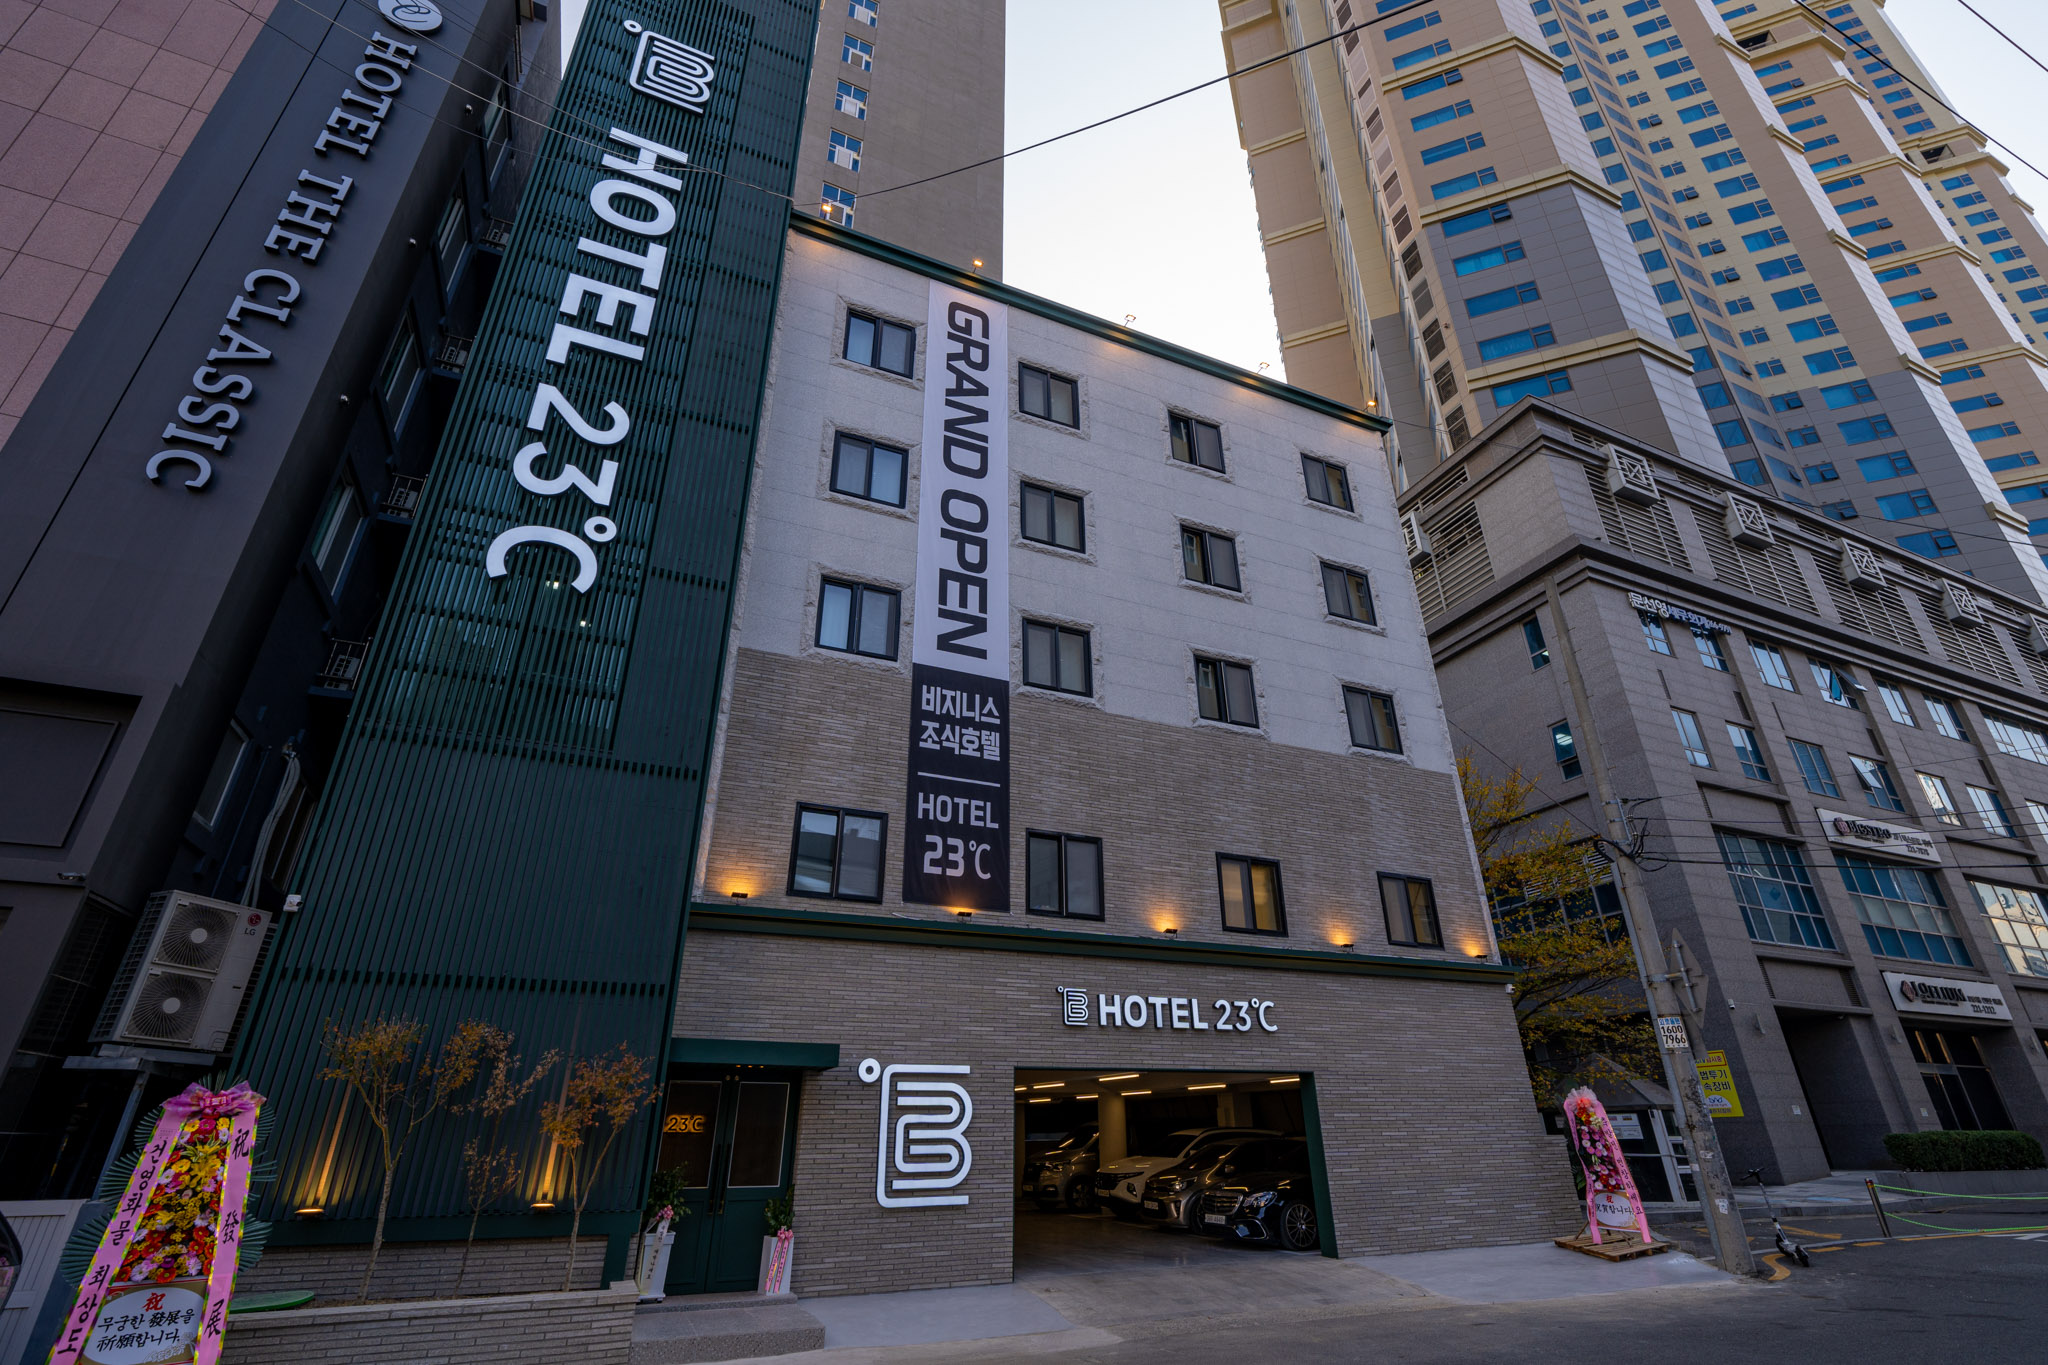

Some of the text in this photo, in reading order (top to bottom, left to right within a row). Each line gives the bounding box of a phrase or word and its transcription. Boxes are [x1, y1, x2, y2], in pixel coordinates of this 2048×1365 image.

[146, 31, 418, 492] HOTEL THE CLASSIC
[546, 127, 689, 366] HOTEL
[936, 301, 990, 660] GRAND OPEN
[921, 684, 1000, 724] 비지니스
[919, 720, 1000, 761] 조식호텔
[917, 792, 999, 829] HOTEL
[244, 927, 256, 936] LG
[1099, 993, 1208, 1029] HOTEL
[1661, 1025, 1683, 1034] 1600
[1663, 1034, 1687, 1044] 7966
[57, 1140, 167, 1355] 건영화물 최상도
[142, 1292, 166, 1312] 祝
[97, 1314, 145, 1333] 무궁한
